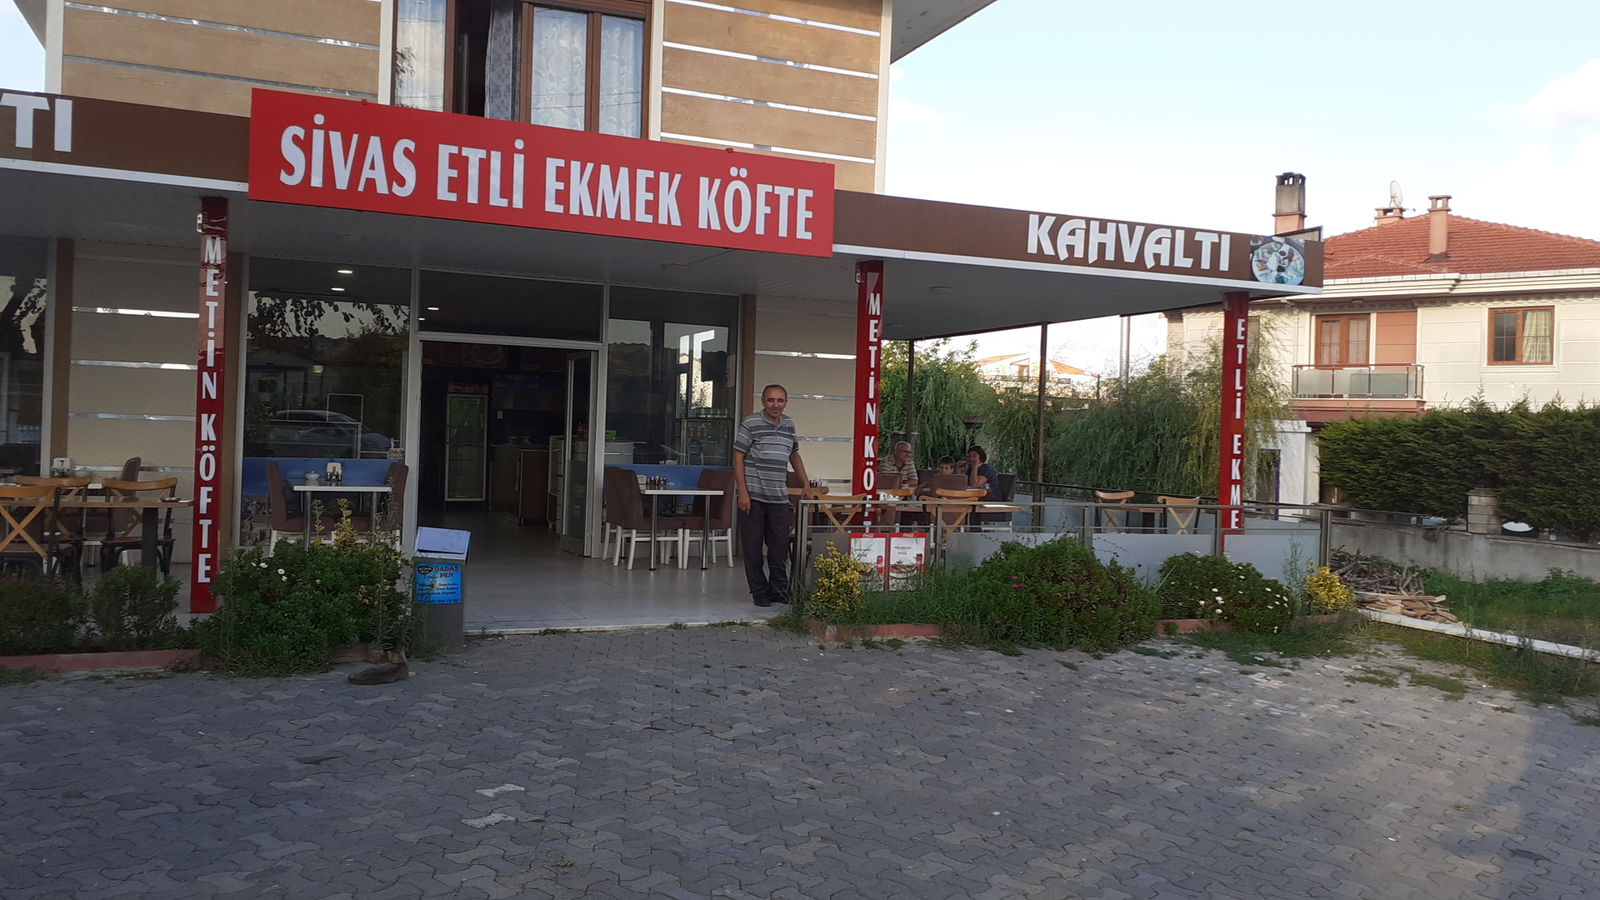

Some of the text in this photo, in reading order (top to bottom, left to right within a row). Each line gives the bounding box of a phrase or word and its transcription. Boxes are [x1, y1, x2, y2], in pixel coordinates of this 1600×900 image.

[279, 113, 814, 241] SİVAS ETLİ EKMEK KÖFTE
[1026, 213, 1231, 272] KAHVALTI
[197, 236, 222, 583] METİN KÖFTE
[865, 293, 881, 425] METİN
[1235, 318, 1246, 420] ETLİ
